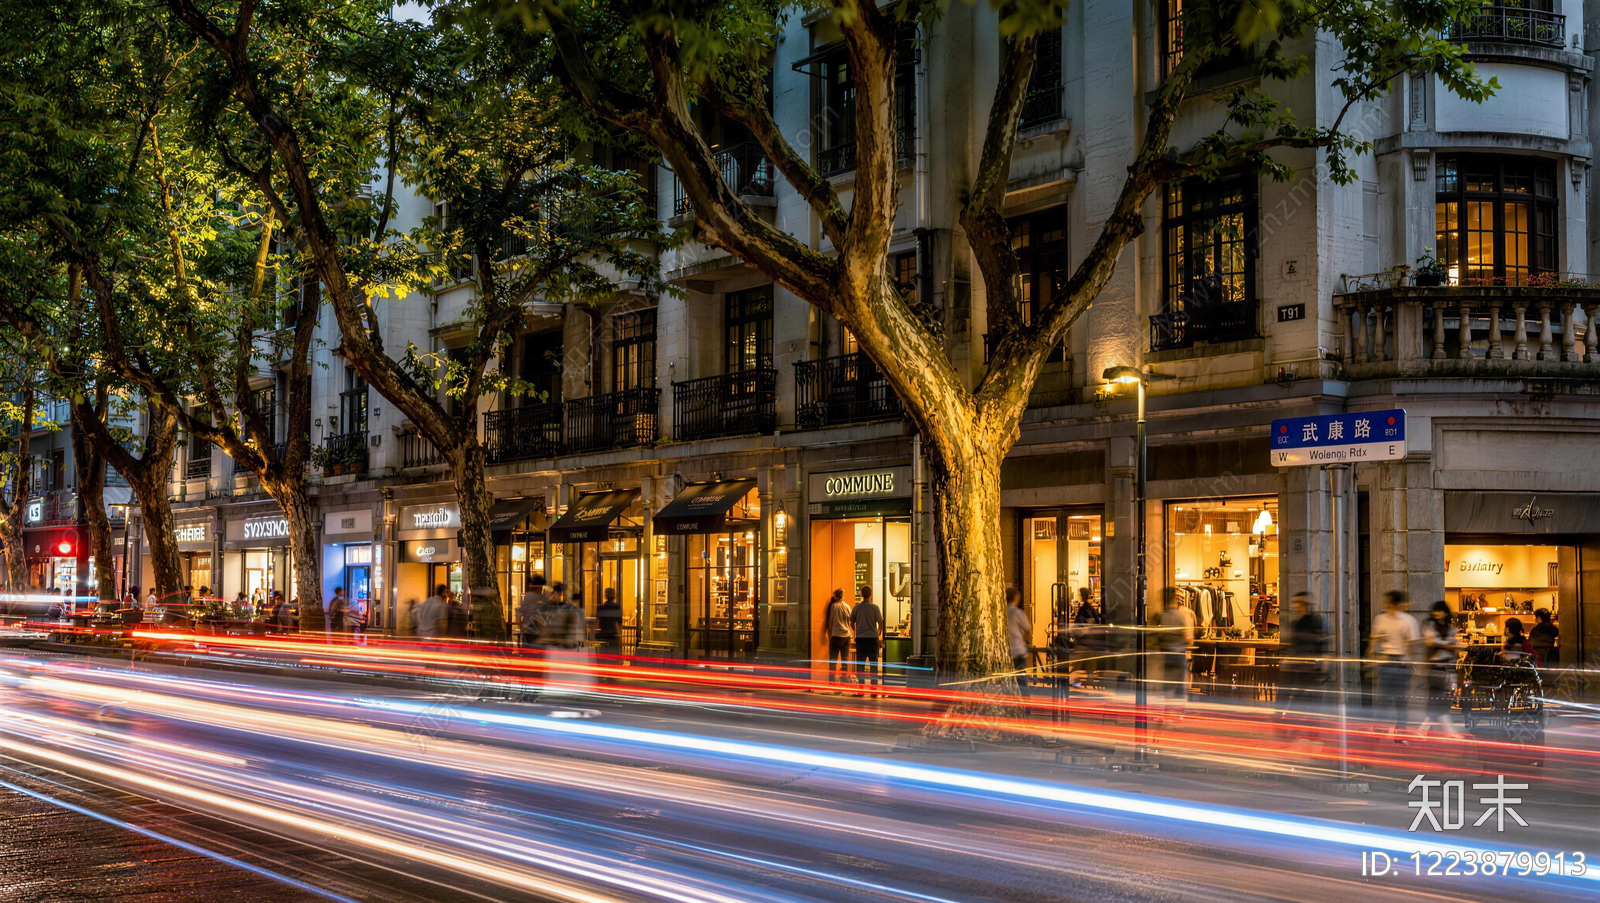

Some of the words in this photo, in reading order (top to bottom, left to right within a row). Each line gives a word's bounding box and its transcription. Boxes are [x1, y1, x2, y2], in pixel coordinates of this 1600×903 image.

[1281, 307, 1299, 320] T91
[1302, 418, 1371, 442] 武康路
[1388, 445, 1396, 455] E
[1279, 452, 1288, 462] W
[825, 473, 894, 495] COMMUNE
